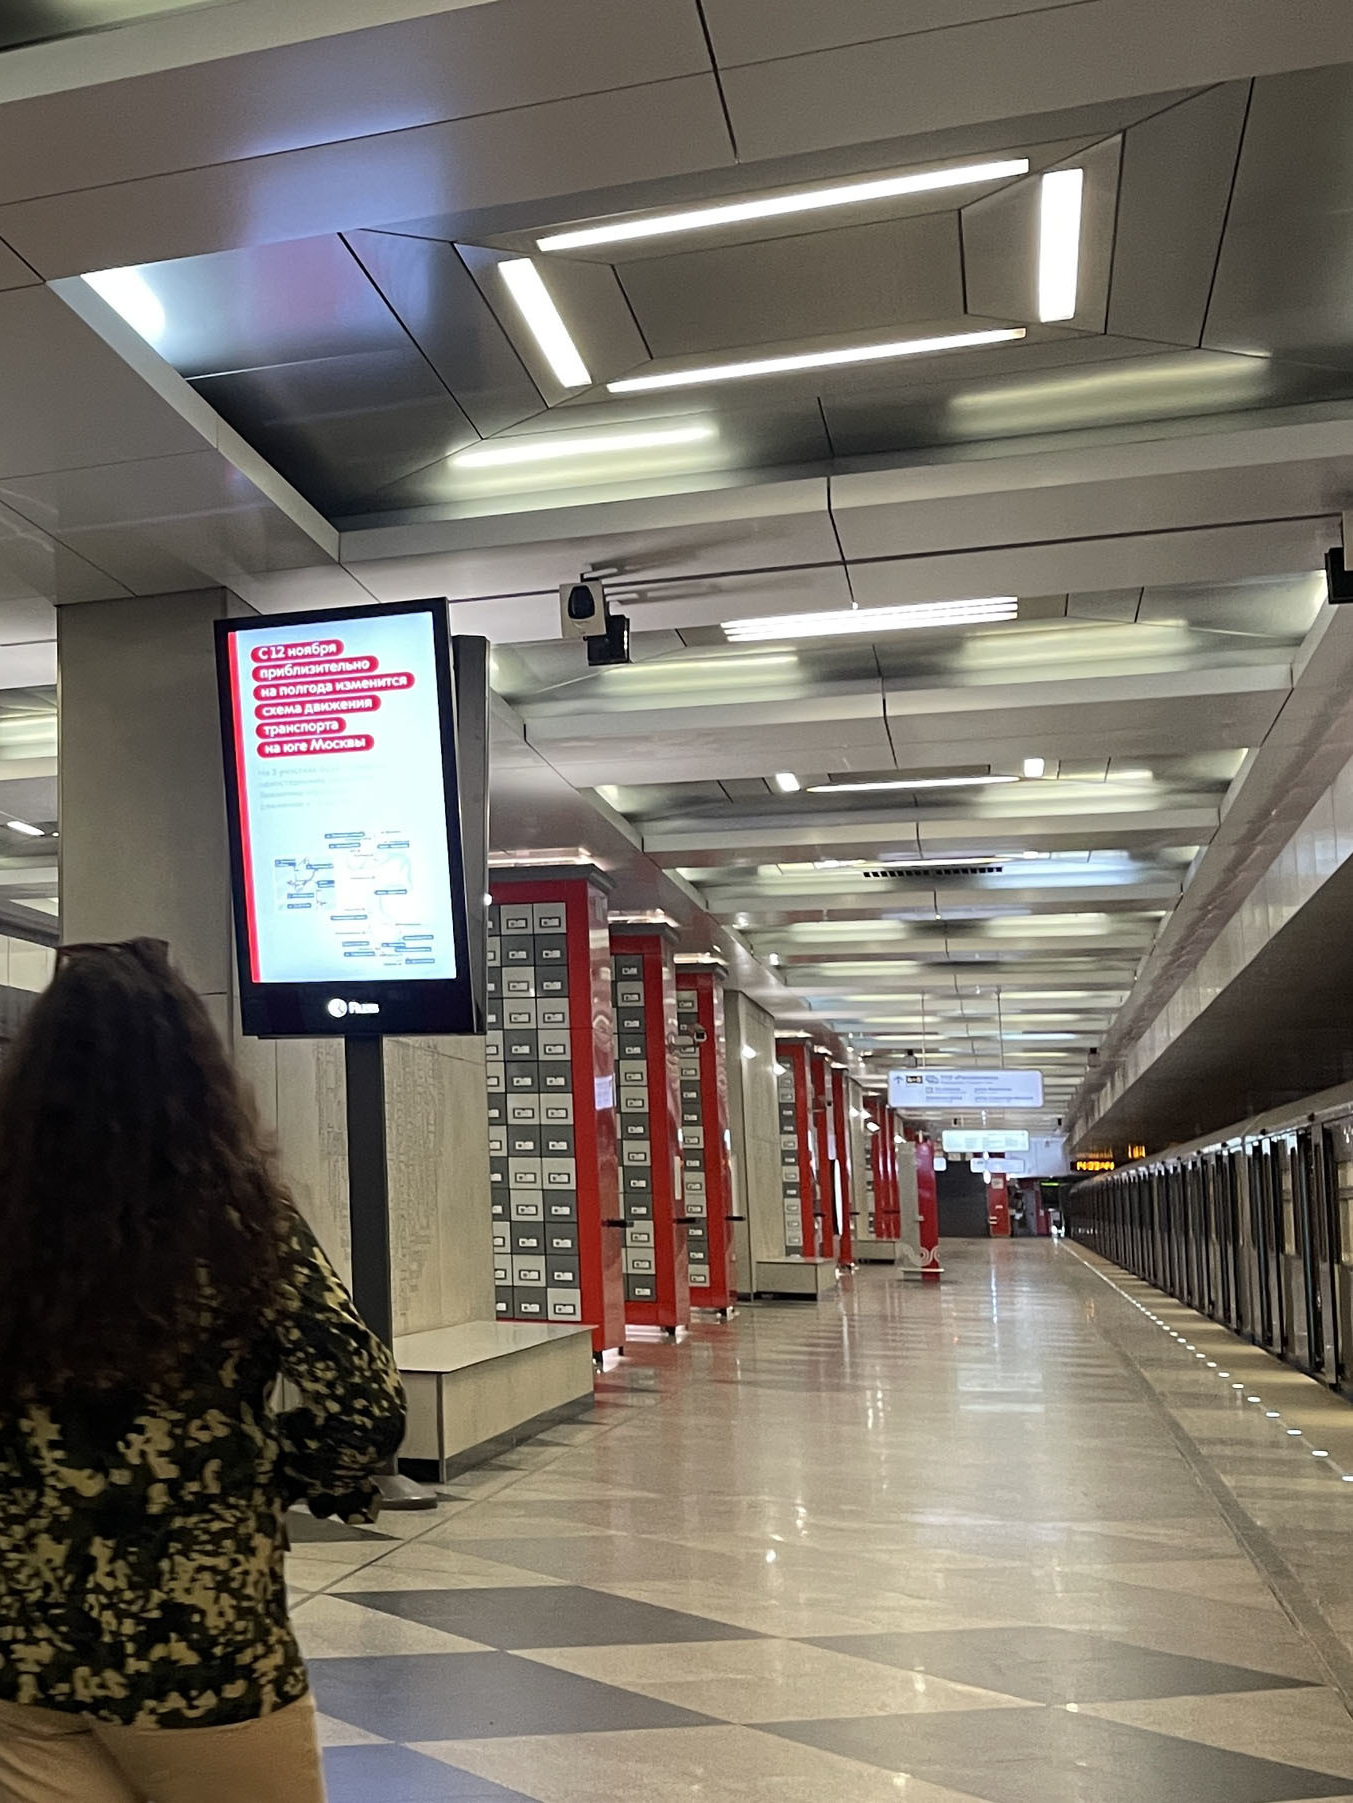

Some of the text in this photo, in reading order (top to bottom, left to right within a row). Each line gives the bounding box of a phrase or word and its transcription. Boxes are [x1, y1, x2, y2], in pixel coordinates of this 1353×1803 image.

[270, 646, 285, 659] 12
[287, 642, 336, 658] ноября
[260, 660, 370, 680] приблизительно
[261, 676, 407, 697] на полгода изменится
[262, 699, 372, 717] схема движения
[263, 720, 339, 737] транспорта
[265, 738, 366, 754] на юге Москвы
